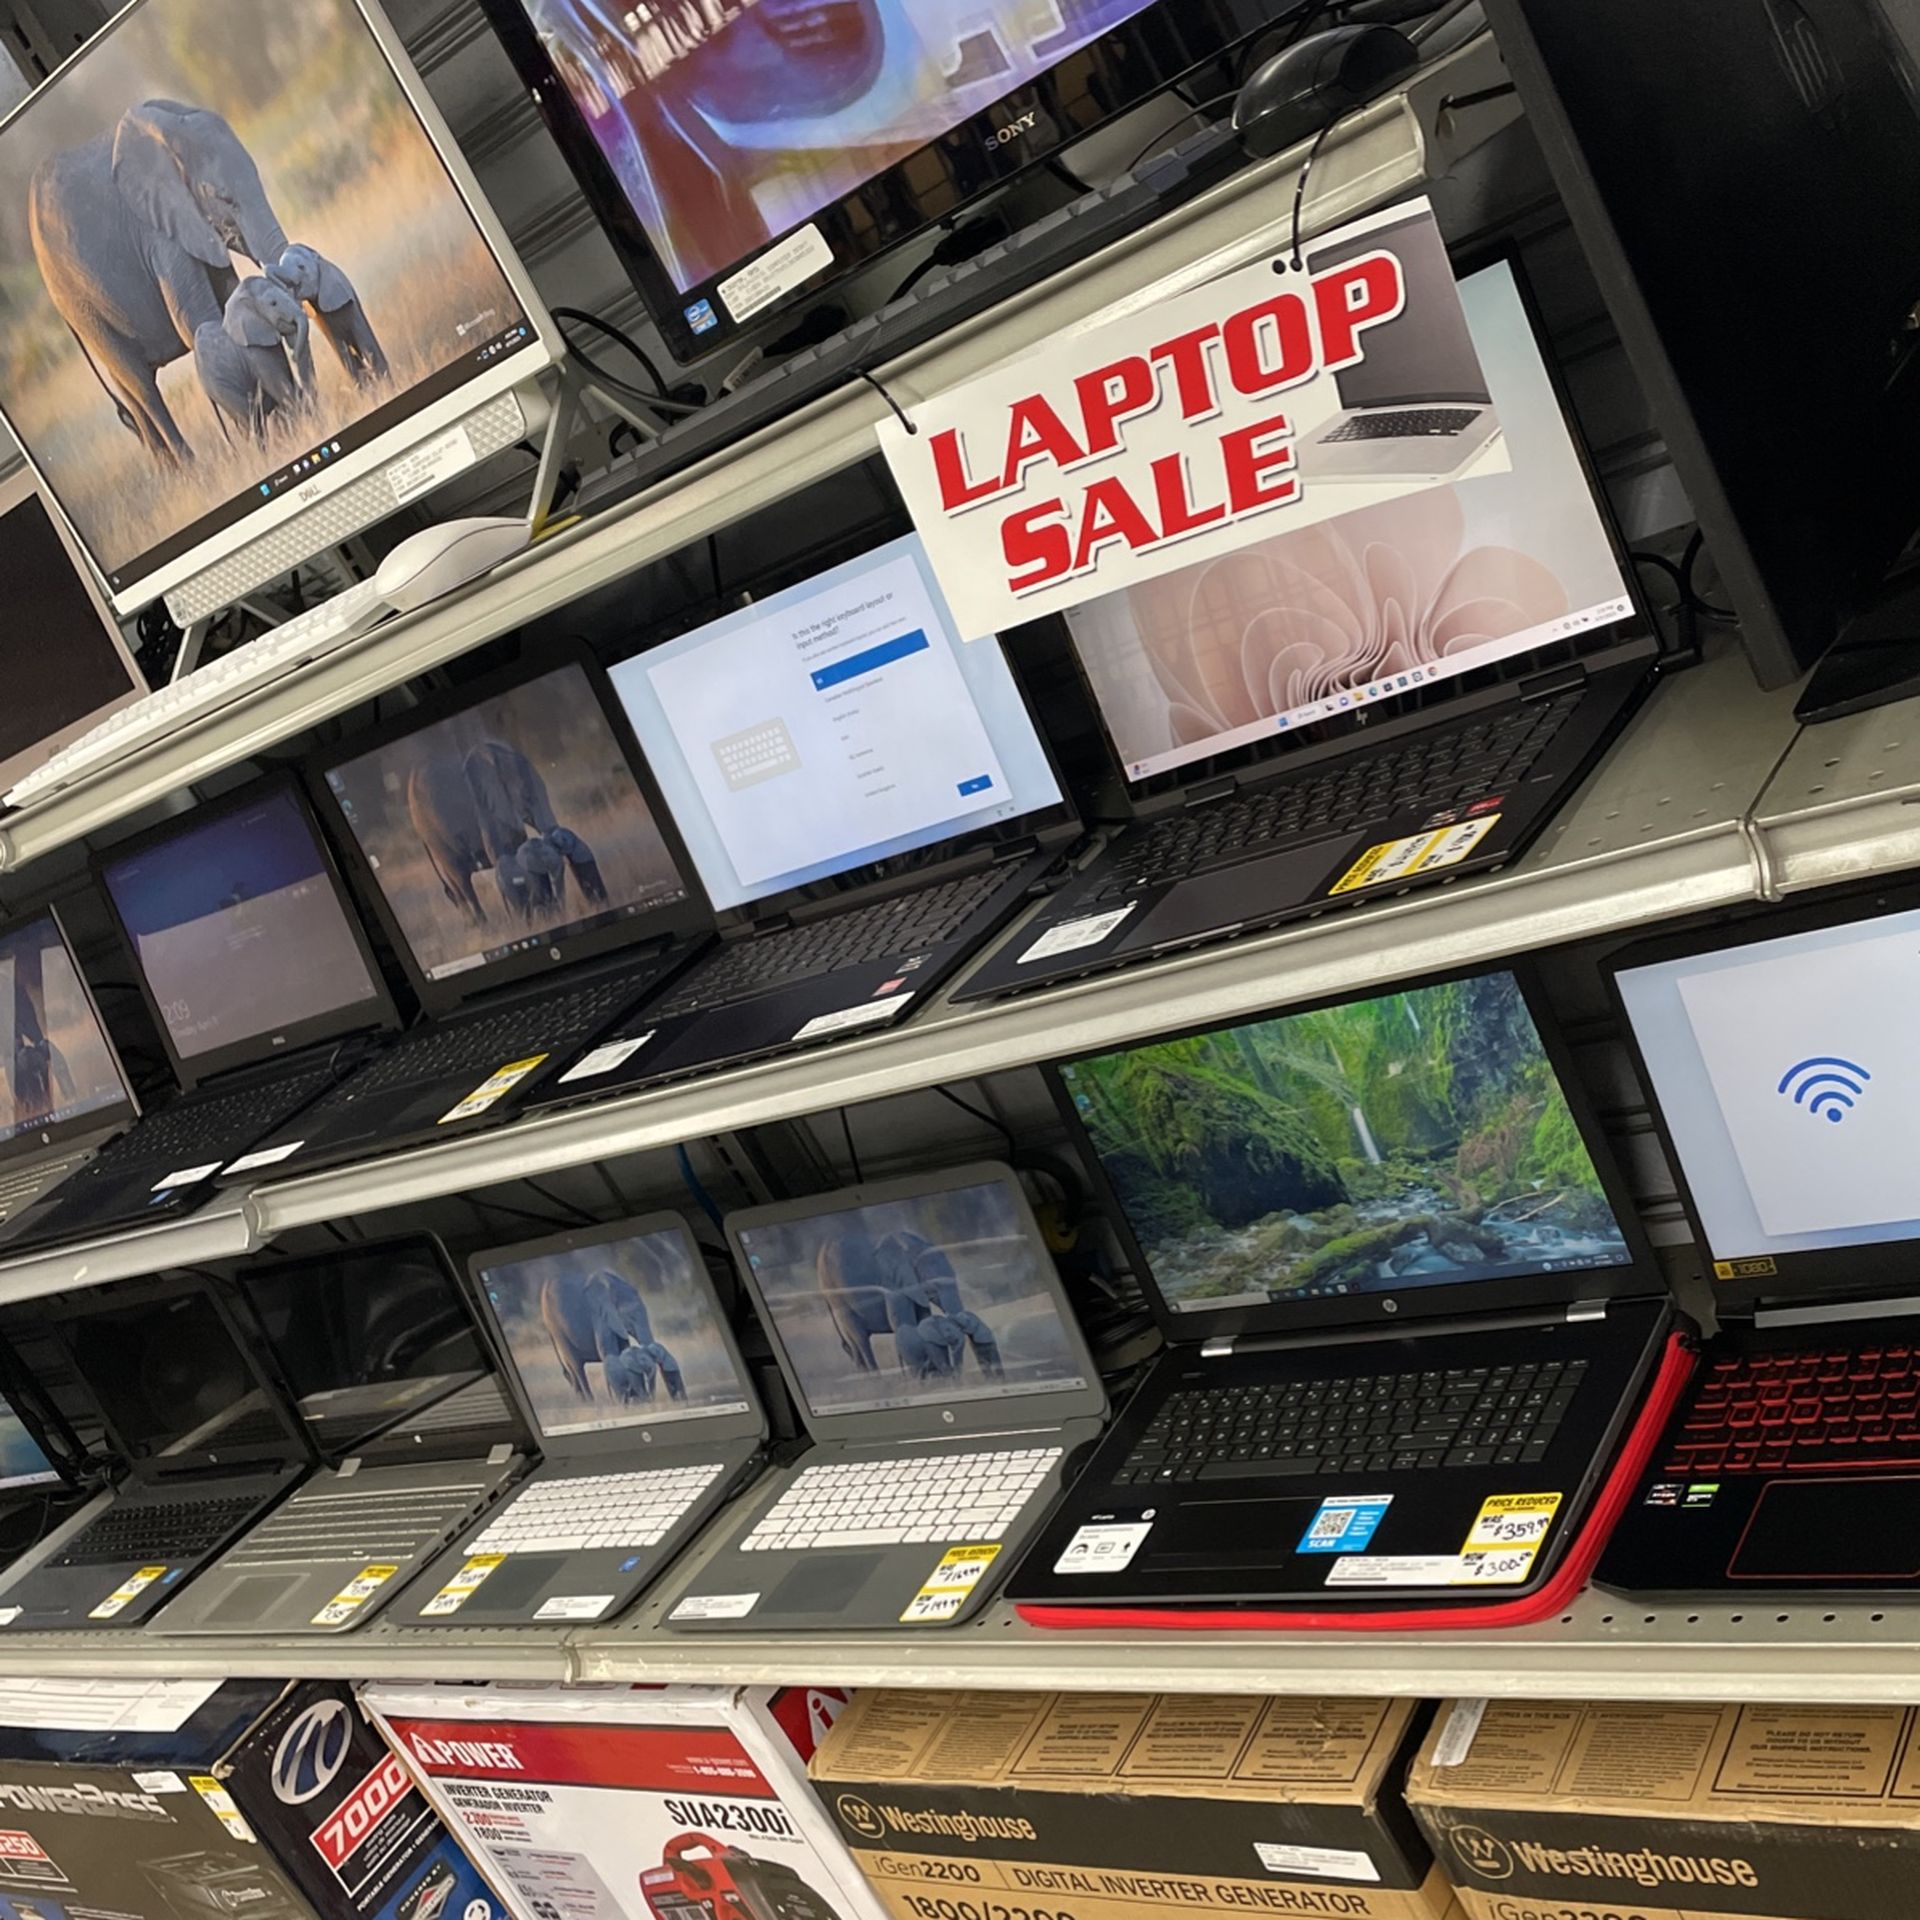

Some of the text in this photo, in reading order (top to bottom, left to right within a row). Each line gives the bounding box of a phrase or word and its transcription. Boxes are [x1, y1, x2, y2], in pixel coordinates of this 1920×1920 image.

[985, 111, 1037, 152] SONY
[929, 252, 1403, 513] LAPTOP
[1000, 415, 1298, 594] SALE
[1481, 1515, 1504, 1524] WAS
[1486, 1496, 1559, 1507] PRICE REDUCED
[1307, 1539, 1336, 1548] SCAN
[324, 1763, 408, 1857] 7000
[443, 1784, 553, 1802] INVERTER GENERATOR
[453, 1797, 545, 1814] GENERADOR INVERTER
[664, 1799, 794, 1835] SUA2300i
[879, 1806, 1037, 1842] Westinghouse
[1511, 1840, 1758, 1888] Westinghouse
[874, 1857, 1370, 1916] iGen2200 DIGITAL INVERTER GENERATOR
